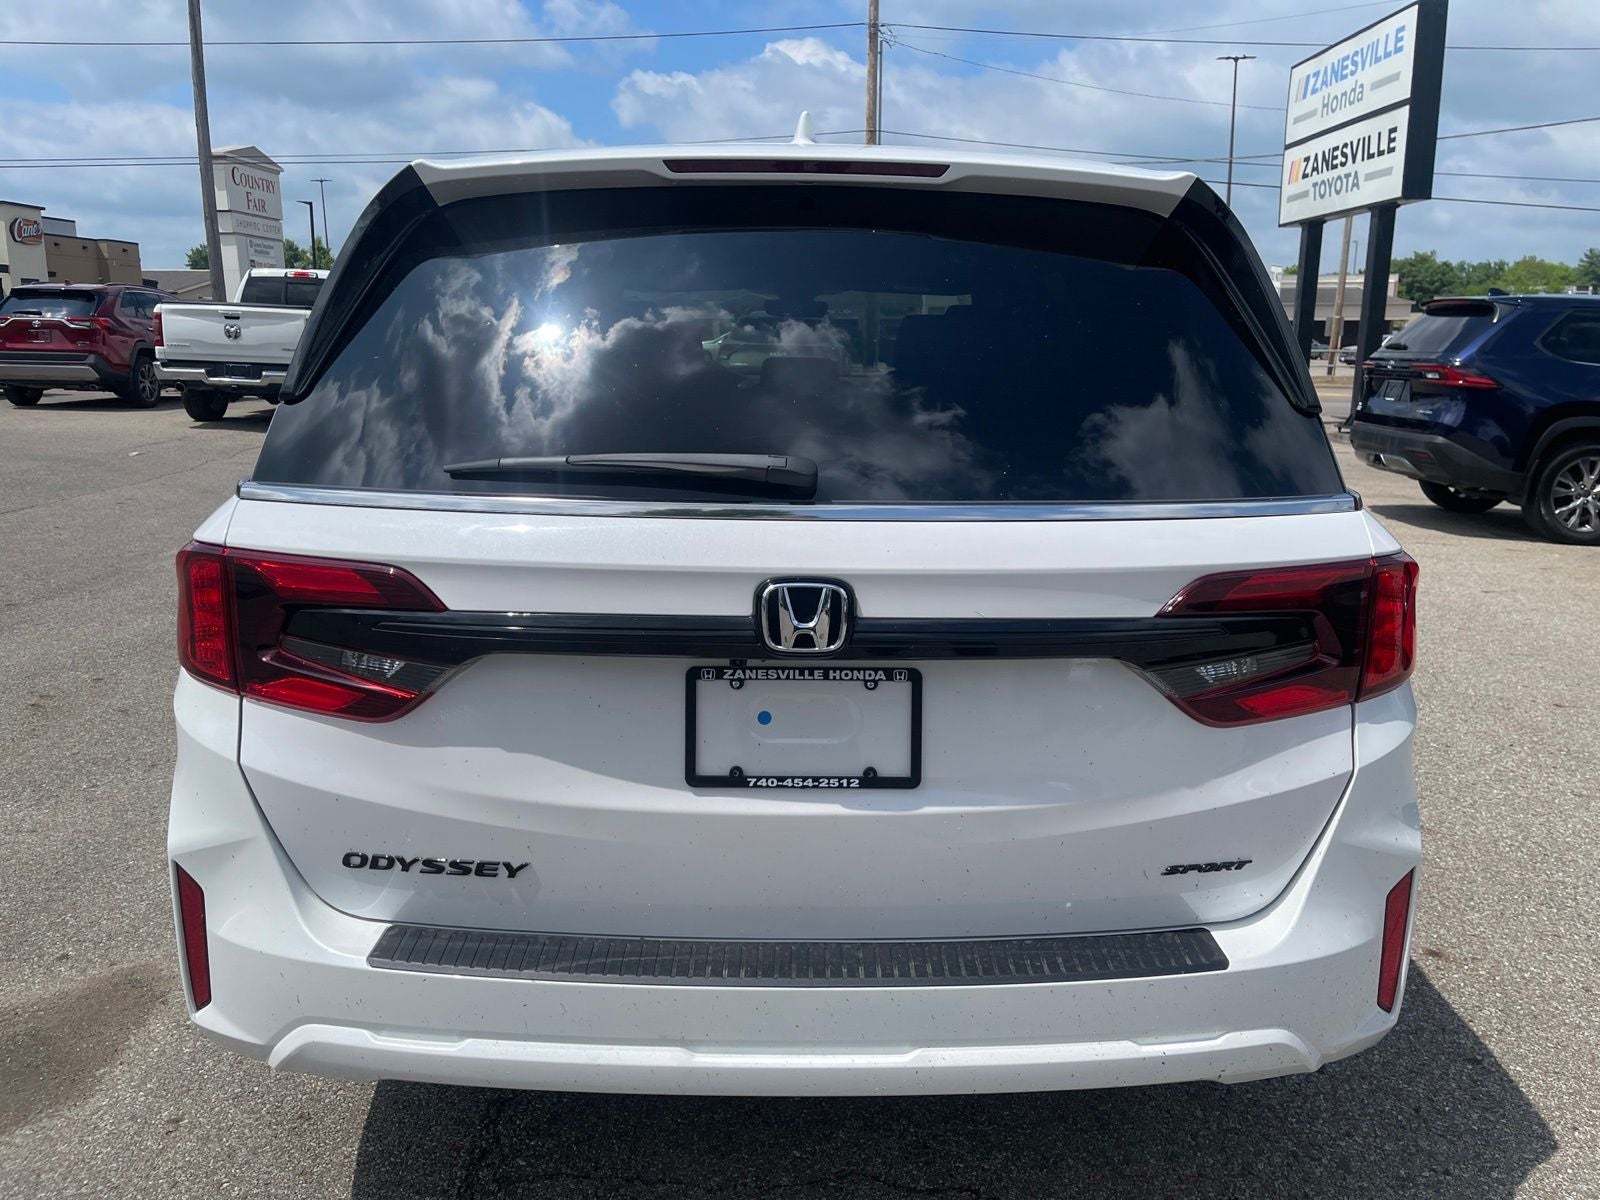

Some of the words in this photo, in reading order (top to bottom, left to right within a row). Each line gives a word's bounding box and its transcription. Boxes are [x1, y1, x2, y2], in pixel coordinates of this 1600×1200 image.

[1310, 24, 1406, 97] ZANESVILLE
[1320, 79, 1365, 118] Honda
[1301, 126, 1398, 180] ZANESVILLE
[231, 166, 276, 195] COUNTRY
[1311, 170, 1360, 201] TOYOTA
[245, 191, 267, 213] FAIR
[722, 669, 824, 680] ZANESVILLE
[829, 670, 887, 681] HONDA
[746, 777, 860, 788] 740-454-2512
[341, 851, 531, 879] ODYSSEY
[1160, 859, 1253, 876] SPORT
